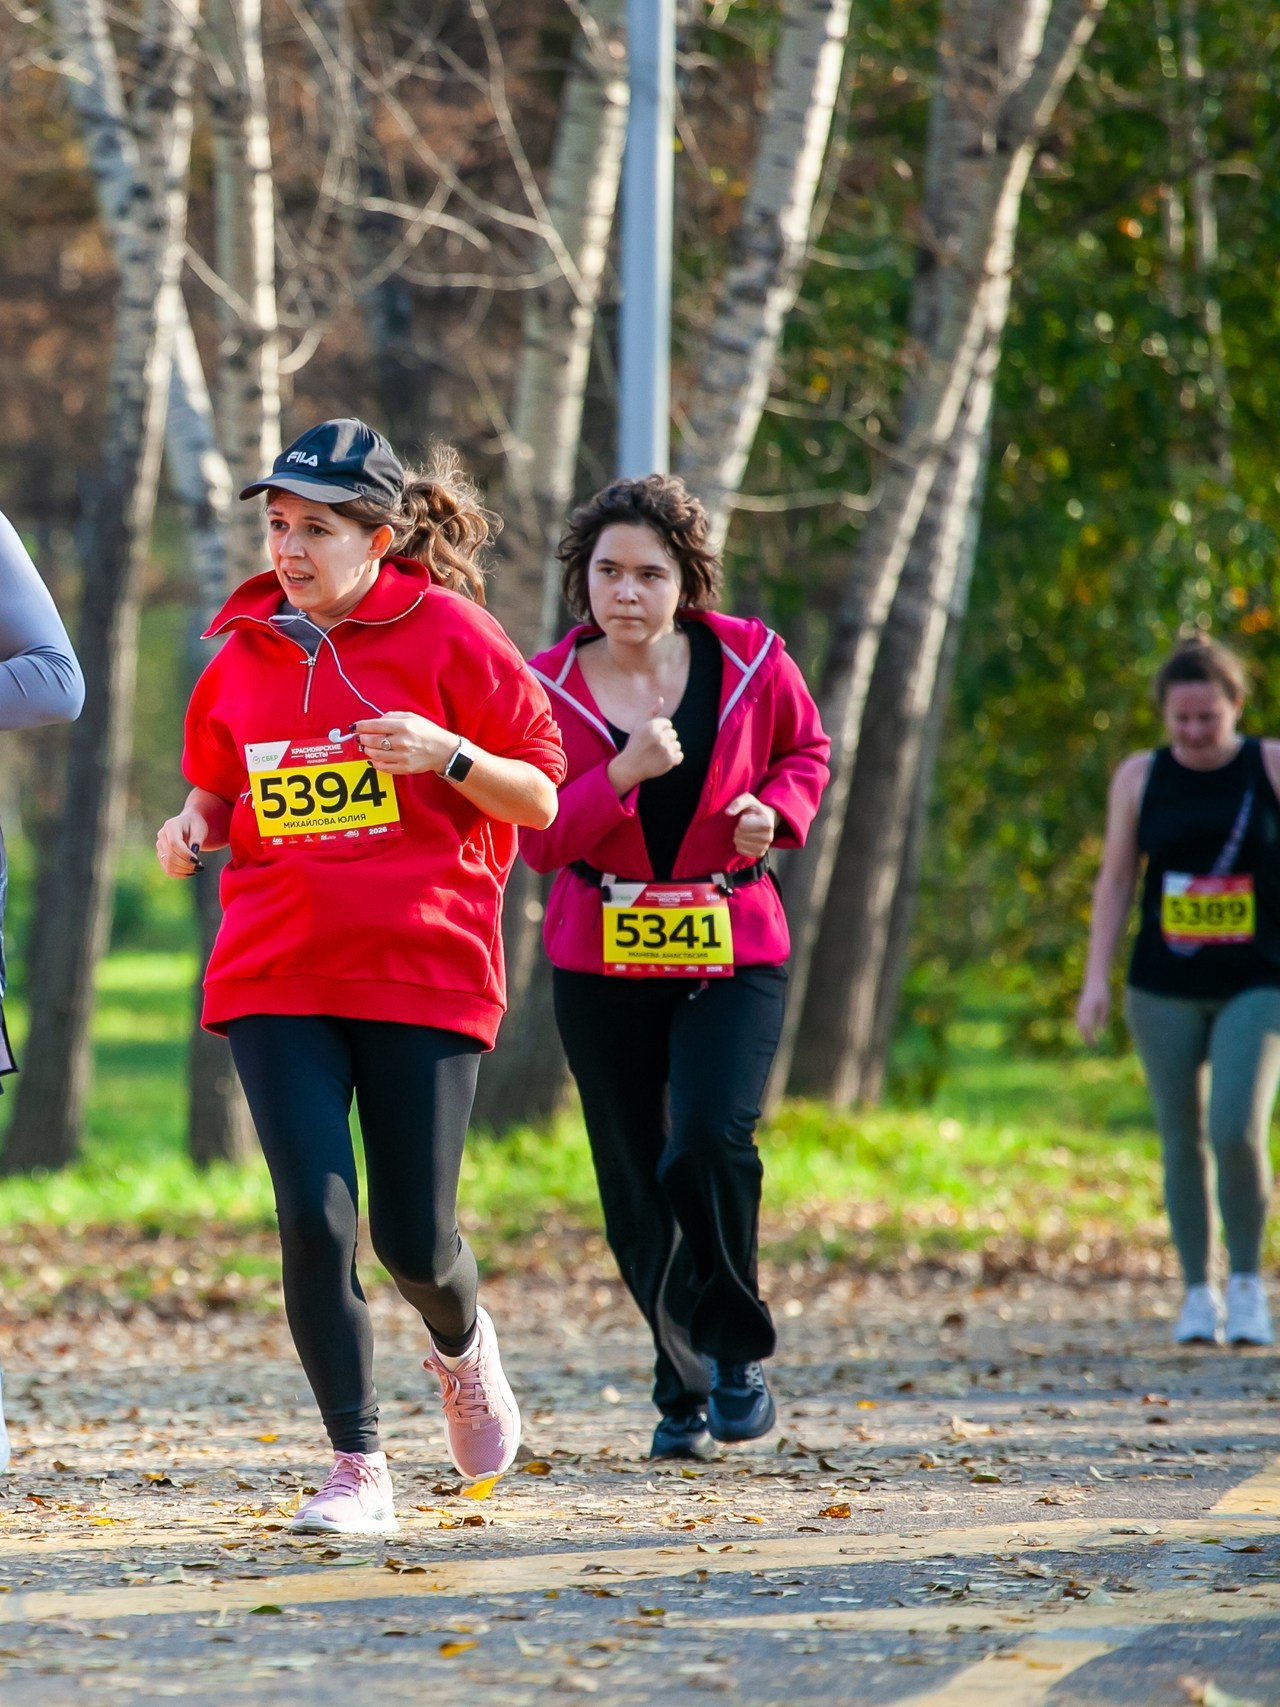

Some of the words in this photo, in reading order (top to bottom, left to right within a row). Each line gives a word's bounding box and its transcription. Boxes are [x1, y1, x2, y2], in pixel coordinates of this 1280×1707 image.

[286, 451, 318, 467] FILA
[291, 743, 342, 754] КРАСНОЯРСКИЕ
[261, 754, 279, 762] СБЕР
[305, 751, 329, 760] МОСТЫ
[260, 766, 387, 819] 5394
[283, 816, 336, 829] МИХАЙЛОВА
[338, 813, 367, 824] ЮЛИЯ
[368, 826, 388, 836] 2026
[615, 913, 722, 949] 5341
